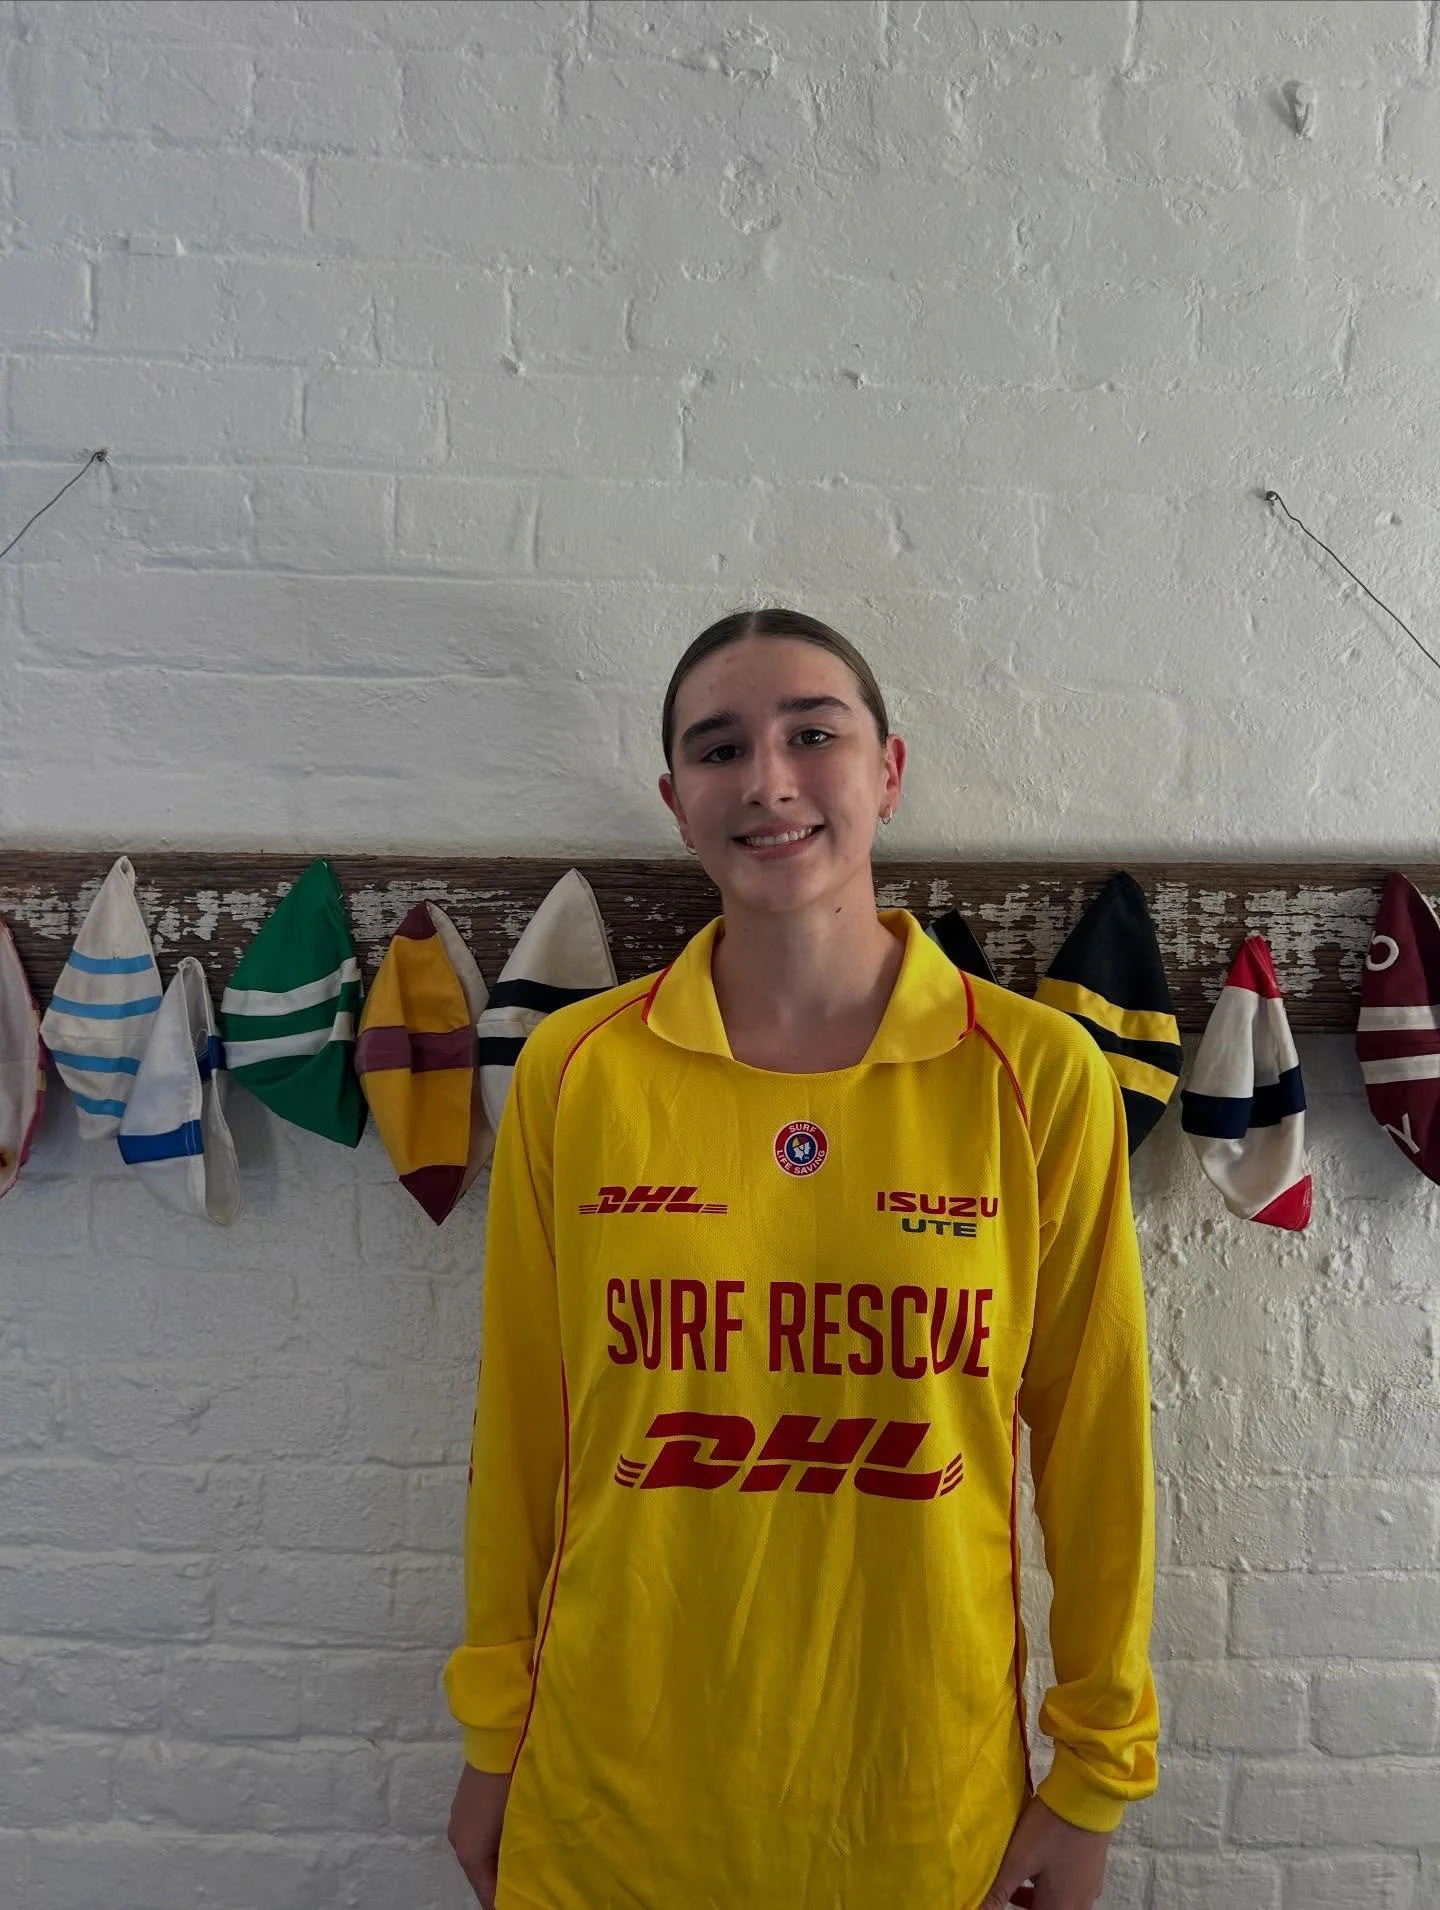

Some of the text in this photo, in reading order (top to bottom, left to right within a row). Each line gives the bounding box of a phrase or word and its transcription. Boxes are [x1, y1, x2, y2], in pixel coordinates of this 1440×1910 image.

[788, 1123, 817, 1133] SURF
[777, 1149, 826, 1175] LIFE SAVING
[596, 1185, 704, 1214] DHL
[877, 1191, 999, 1218] ISUZU
[901, 1217, 977, 1238] UTE
[606, 1277, 993, 1380] SURF RESCUE
[639, 1411, 944, 1501] DHL
